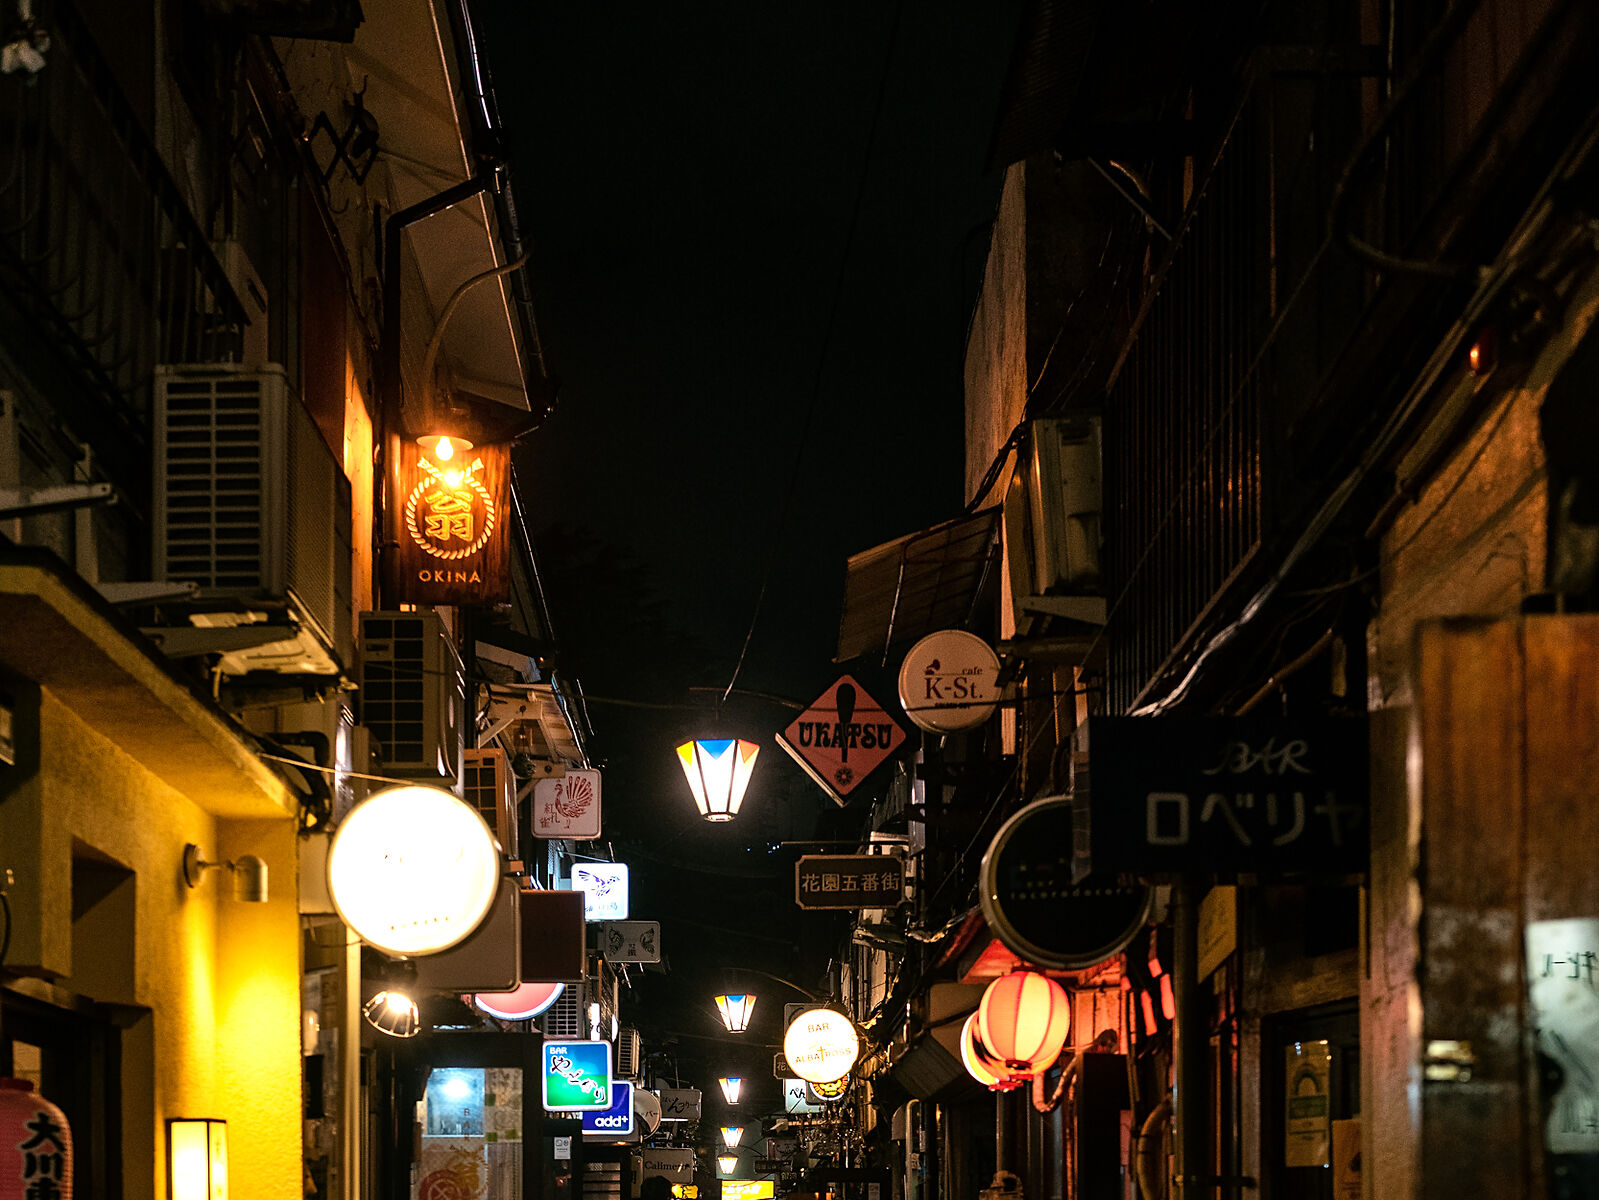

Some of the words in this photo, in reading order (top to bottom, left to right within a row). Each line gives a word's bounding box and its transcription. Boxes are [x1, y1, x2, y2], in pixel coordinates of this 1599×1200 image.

[418, 569, 481, 584] OKINA
[924, 676, 983, 699] K-St.
[798, 722, 893, 749] UKATSU
[1202, 737, 1317, 776] BAR
[1144, 788, 1367, 848] ロベリヤ
[801, 872, 900, 893] 花園五番街
[808, 1022, 830, 1033] BAR
[549, 1046, 568, 1055] BAR
[795, 1045, 852, 1064] ALBATROSS
